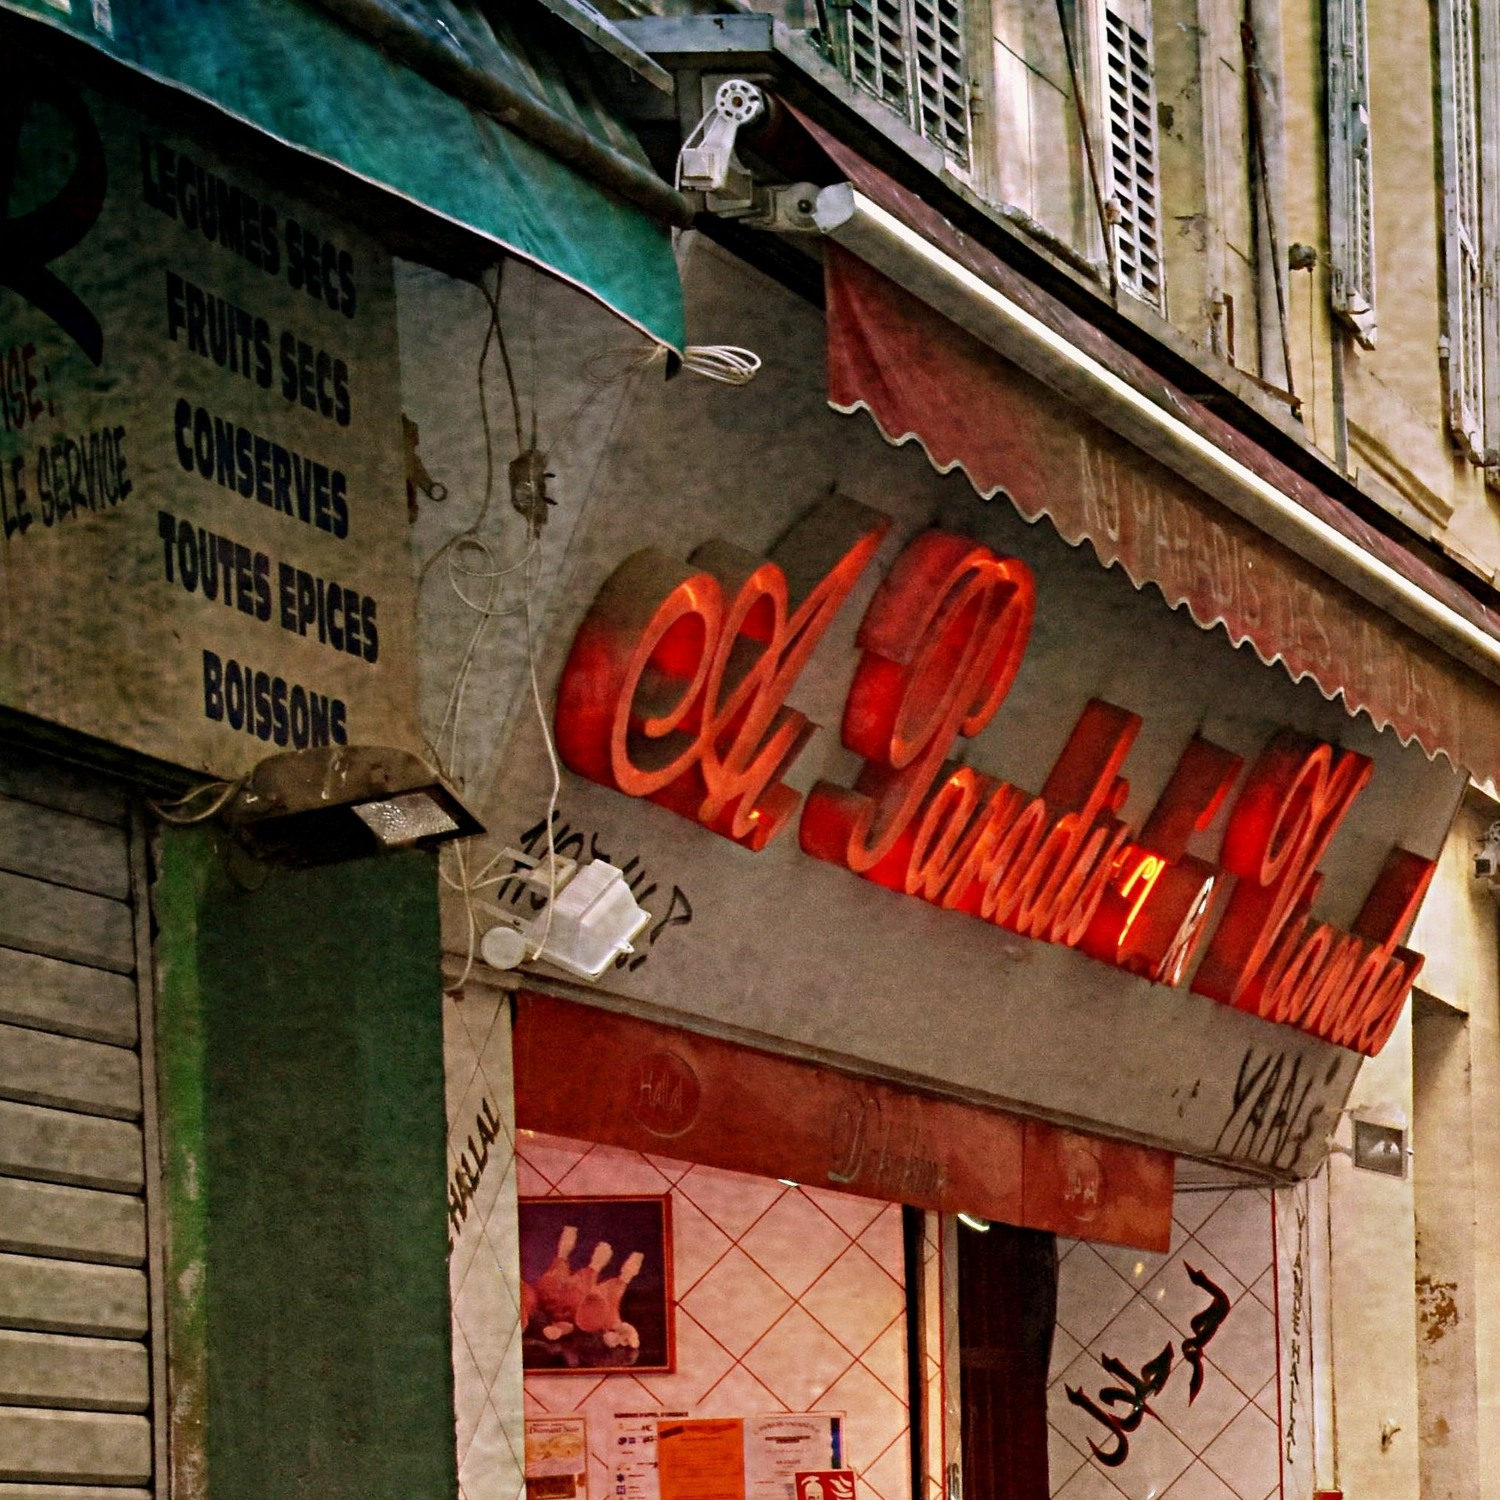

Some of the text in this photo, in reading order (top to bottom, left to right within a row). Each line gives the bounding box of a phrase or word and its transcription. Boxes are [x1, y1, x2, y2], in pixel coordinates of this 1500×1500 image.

[138, 131, 356, 319] LEGUMES SECS
[165, 270, 351, 427] FRUITS SECS
[37, 425, 132, 527] SERVICE
[174, 398, 349, 539] CONSERVES
[158, 510, 379, 664] TOUTES EPICES
[203, 648, 348, 750] BOISSONS
[1063, 1340, 1176, 1468] حلال
